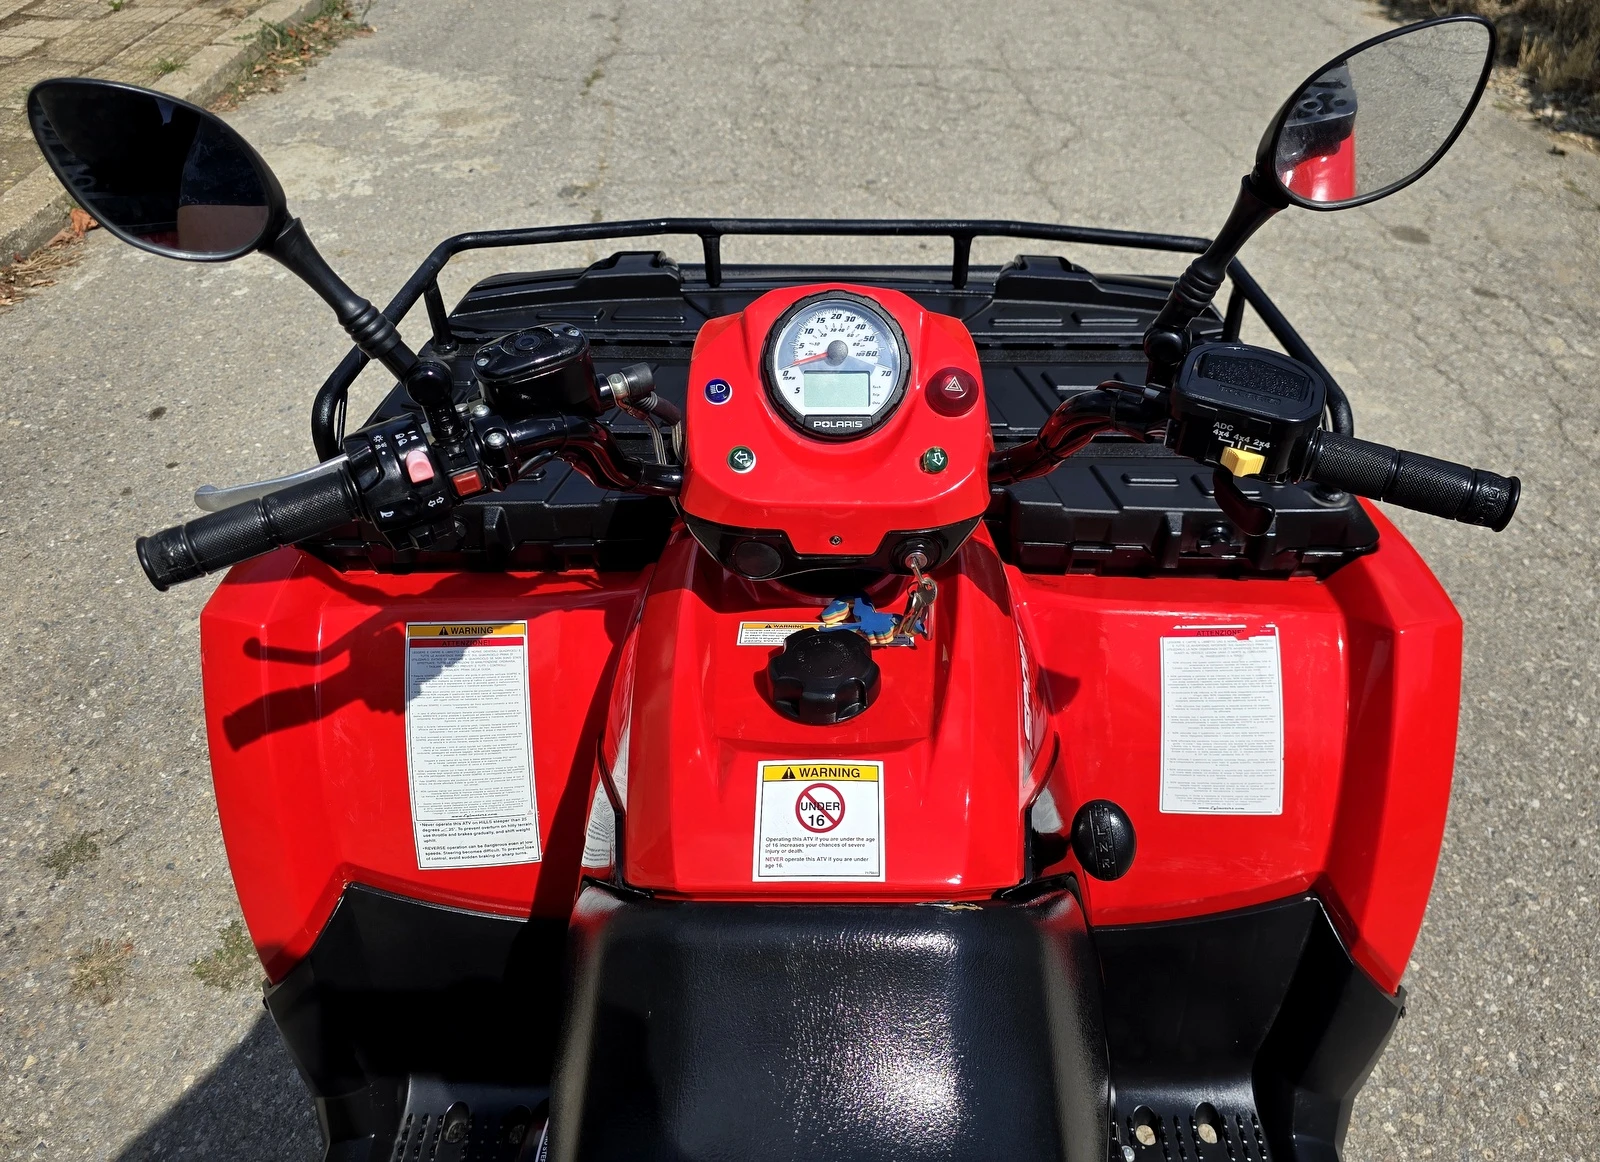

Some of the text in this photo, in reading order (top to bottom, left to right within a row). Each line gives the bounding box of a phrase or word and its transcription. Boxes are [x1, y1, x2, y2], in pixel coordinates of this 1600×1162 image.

[1213, 422, 1234, 432] ADC
[1213, 429, 1271, 449] 4x4 4x4 2x4
[450, 627, 494, 635] WARNING
[799, 768, 860, 778] WARNING
[800, 802, 840, 811] UNDER
[808, 815, 825, 826] 16
[1100, 842, 1109, 852] N
[1102, 859, 1110, 868] R
